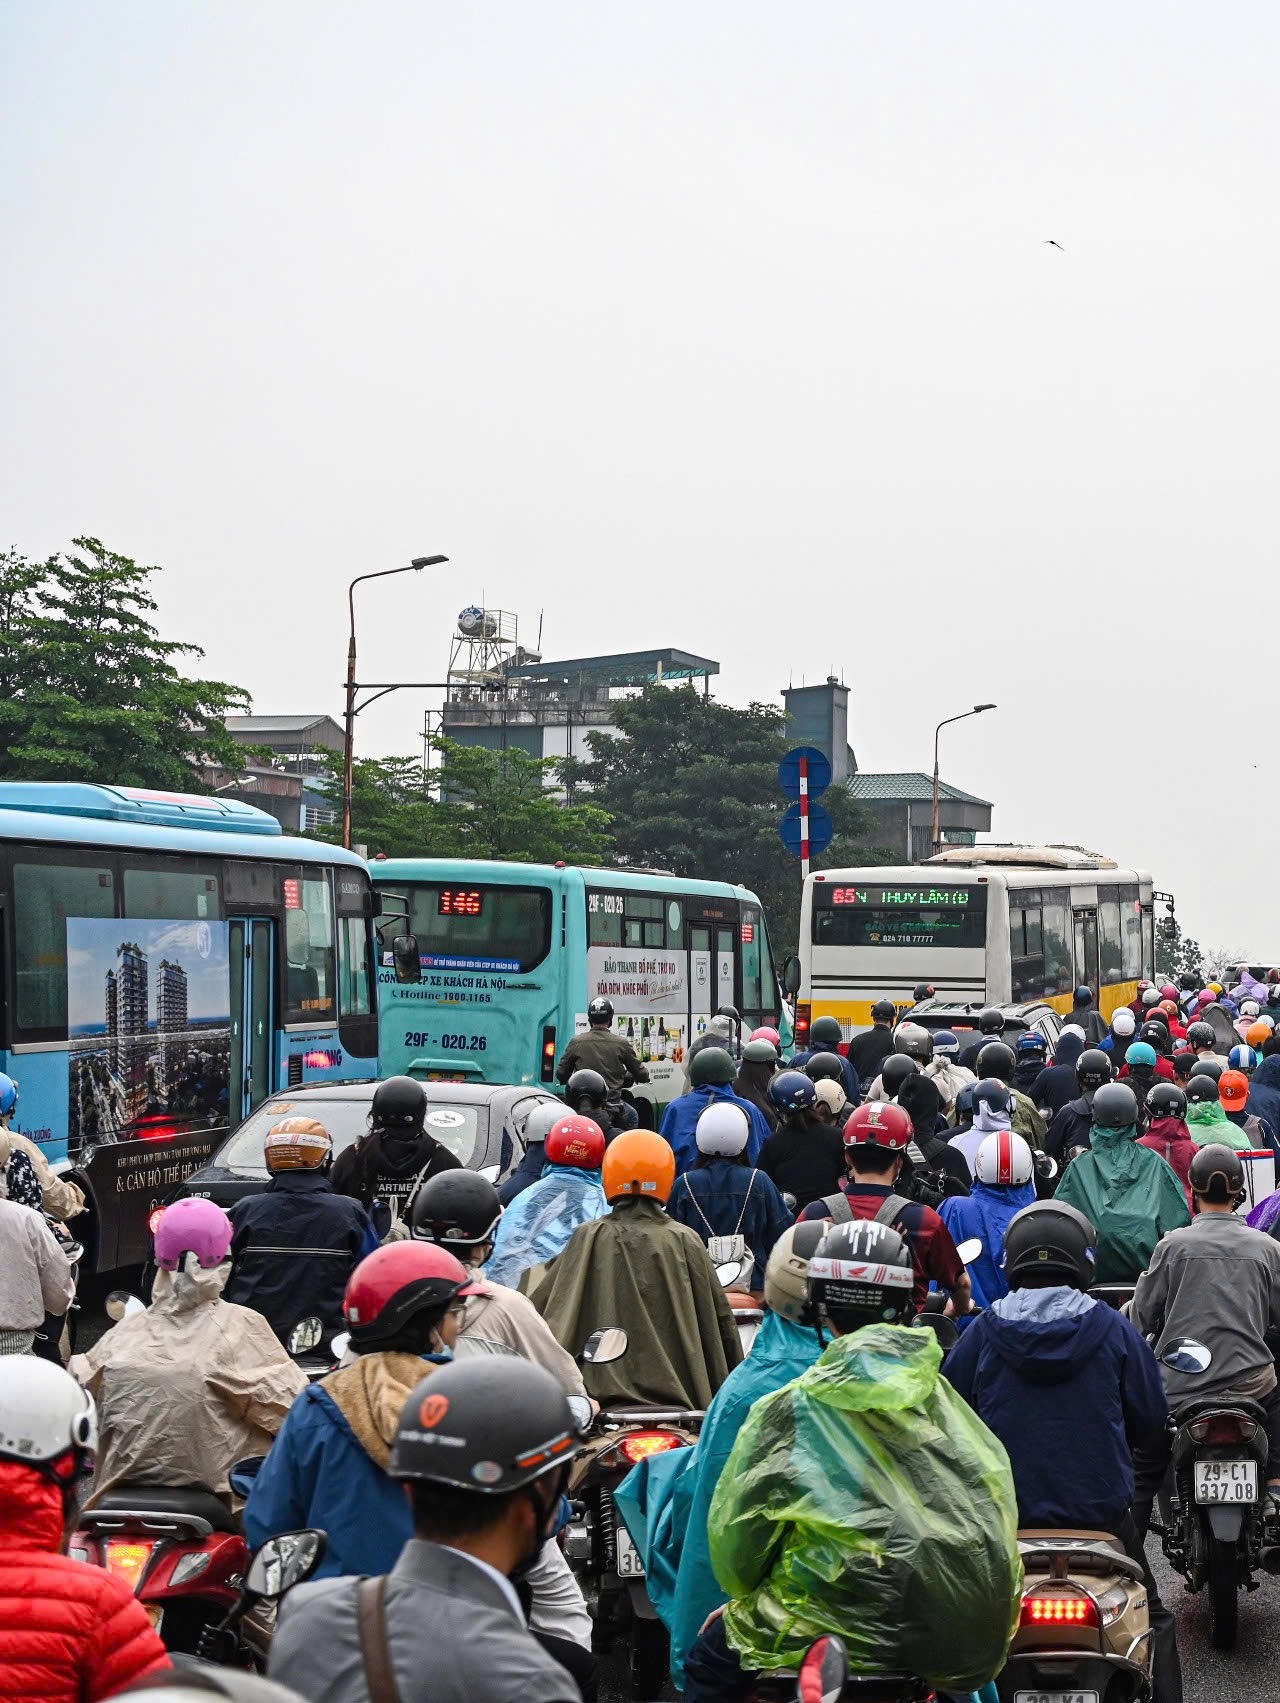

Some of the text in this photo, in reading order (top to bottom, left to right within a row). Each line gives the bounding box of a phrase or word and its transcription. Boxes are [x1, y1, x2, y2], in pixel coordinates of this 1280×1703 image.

[440, 889, 480, 914] 146
[617, 961, 638, 974] THANH
[430, 974, 506, 991] XE KHÁCH HÀ NỘI
[400, 990, 491, 1003] Hotline 1900.1165
[404, 1032, 487, 1051] 29F 020.26
[116, 1176, 124, 1192] &
[1204, 1464, 1247, 1481] 29-C1
